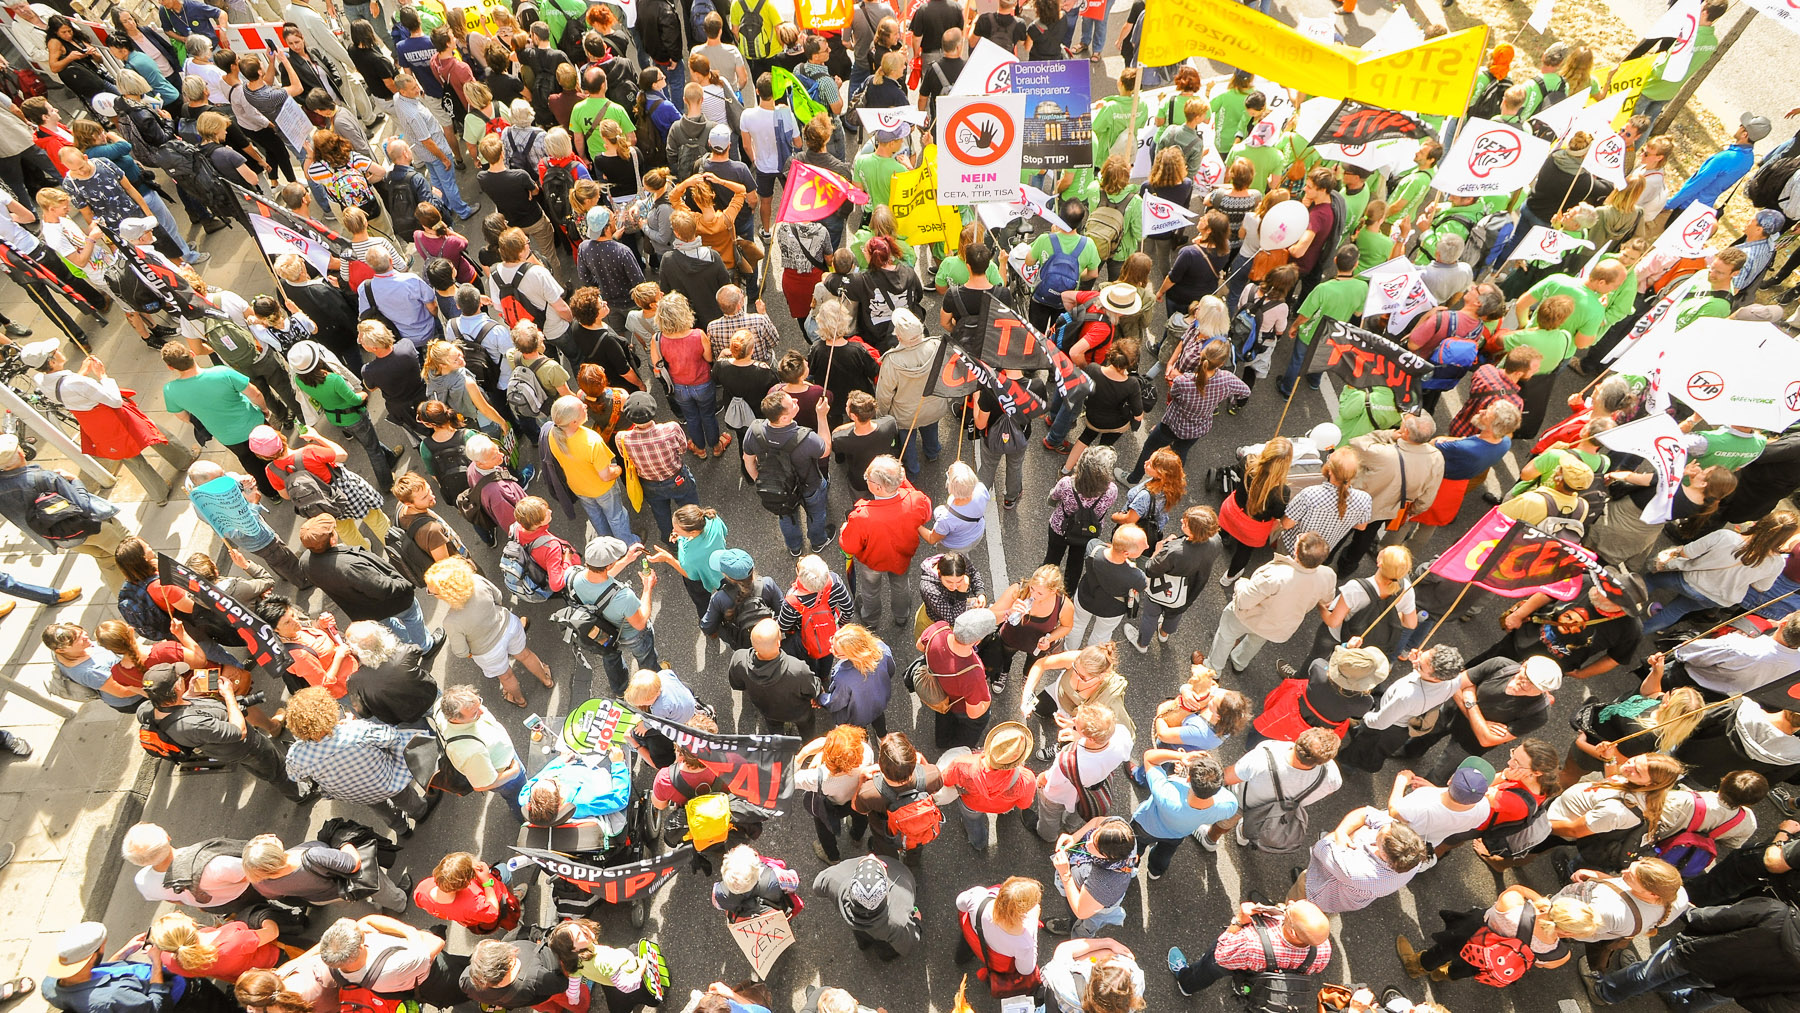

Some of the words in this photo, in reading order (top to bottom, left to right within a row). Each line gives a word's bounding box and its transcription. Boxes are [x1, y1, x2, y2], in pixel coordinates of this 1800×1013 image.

[1014, 63, 1066, 74] Demokratie
[1016, 75, 1050, 85] braucht
[1016, 86, 1071, 97] Transparenz
[1023, 155, 1043, 164] Stop
[1044, 155, 1069, 164] TTIP!
[961, 173, 997, 183] NEIN
[1457, 182, 1500, 193] GREENPEACE
[943, 191, 969, 199] CETA,
[972, 190, 992, 198] TTIP,
[994, 189, 1014, 197] TISA
[1693, 374, 1720, 395] TTIP
[598, 708, 621, 751] STOP
